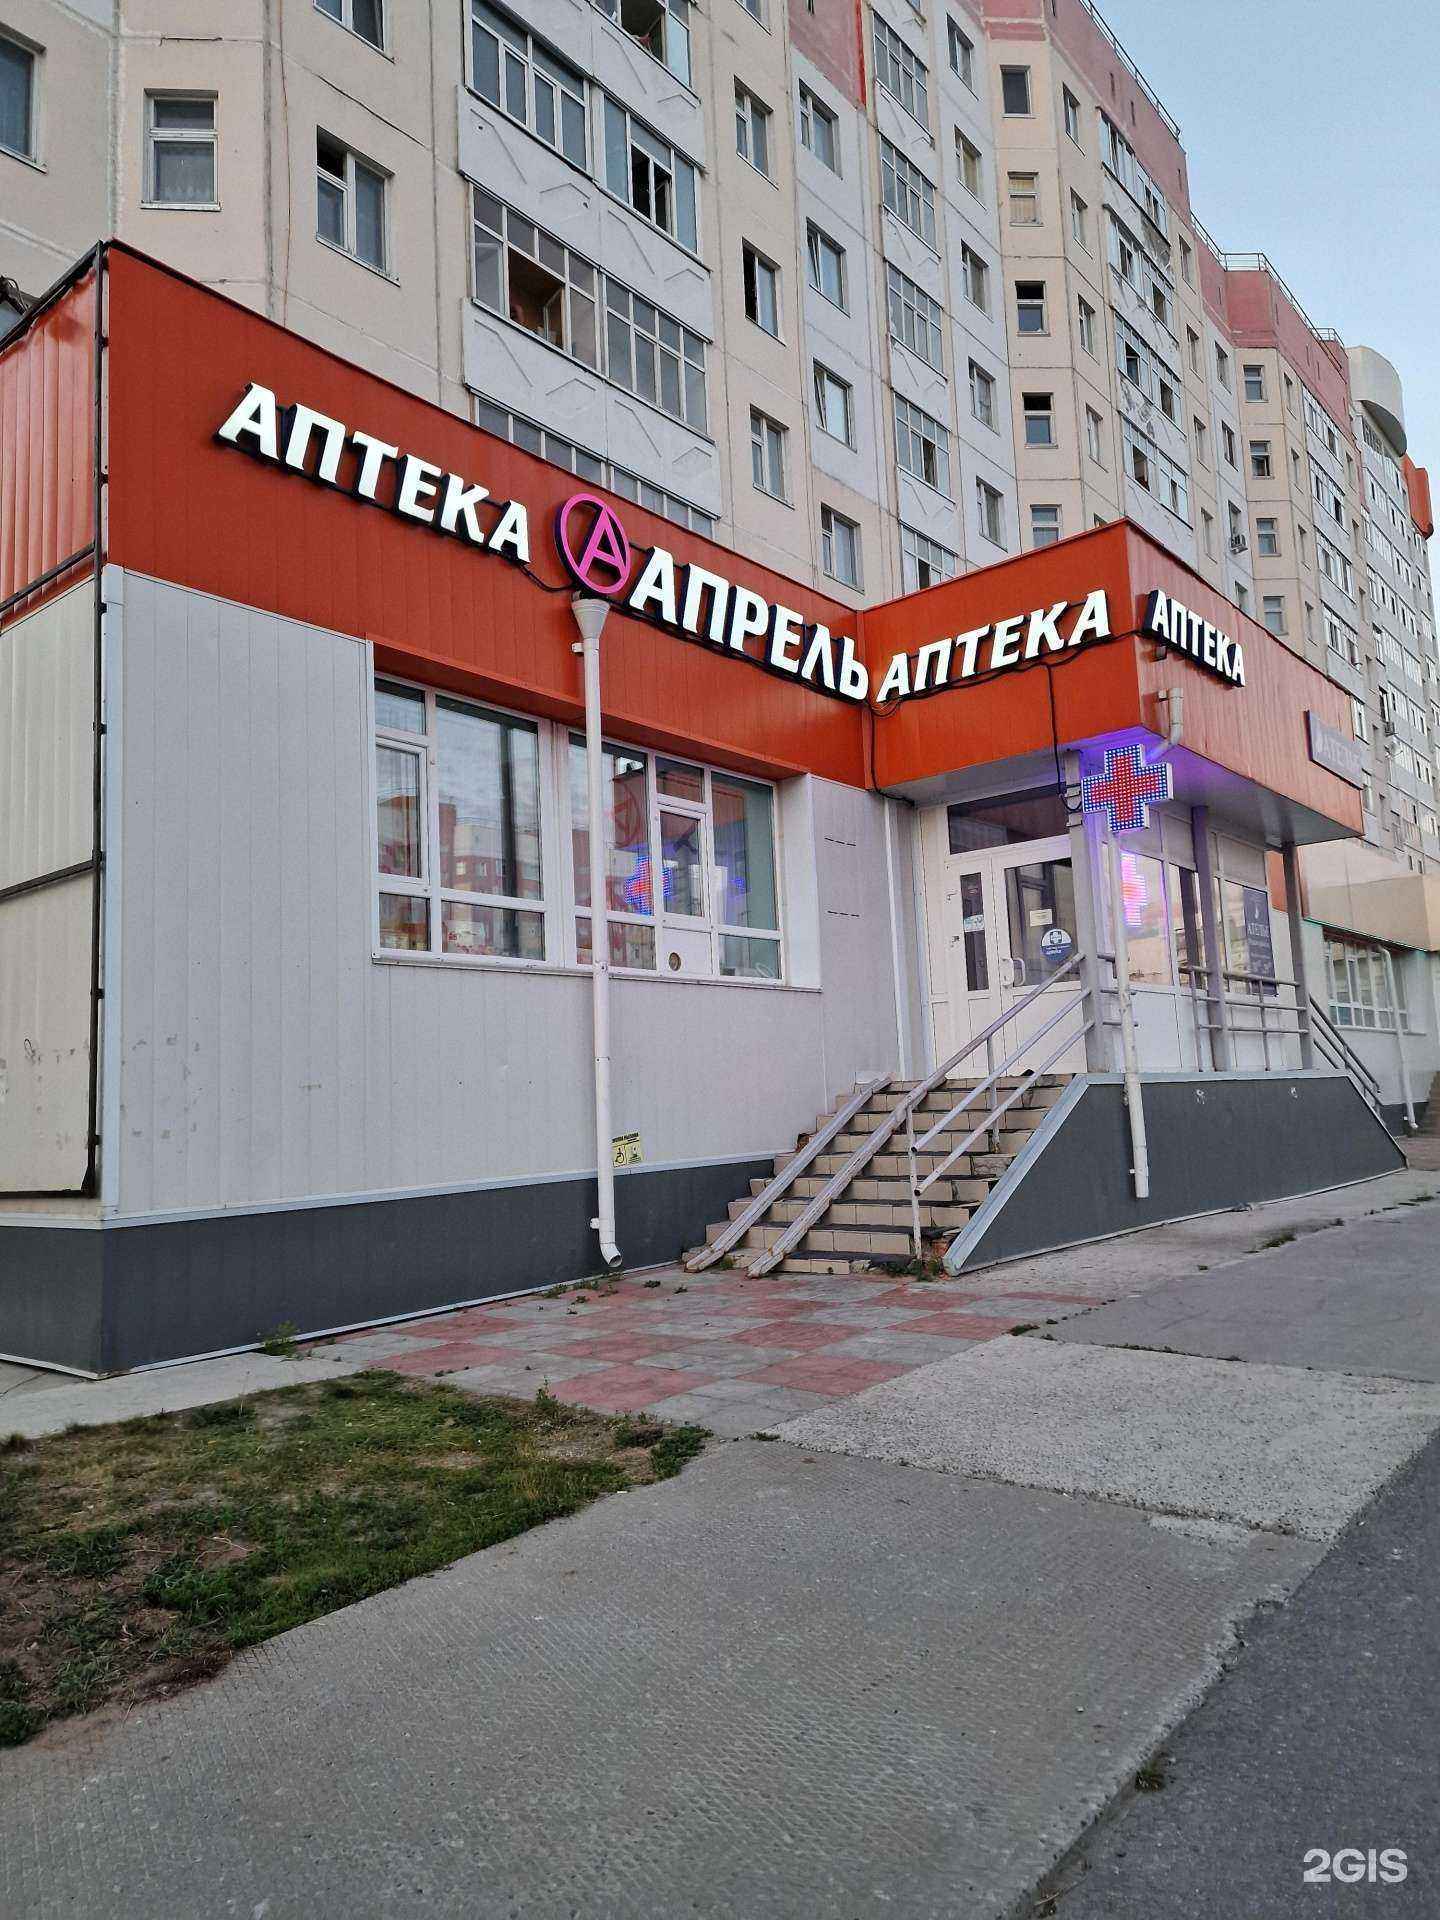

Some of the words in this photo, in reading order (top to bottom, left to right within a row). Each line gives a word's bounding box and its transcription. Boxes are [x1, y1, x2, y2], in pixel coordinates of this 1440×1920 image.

[218, 381, 531, 564] АПТЕКА
[629, 546, 869, 701] АПРЕЛЬ
[876, 589, 1112, 702] АПТЕКА
[1152, 589, 1246, 687] АПТЕКА
